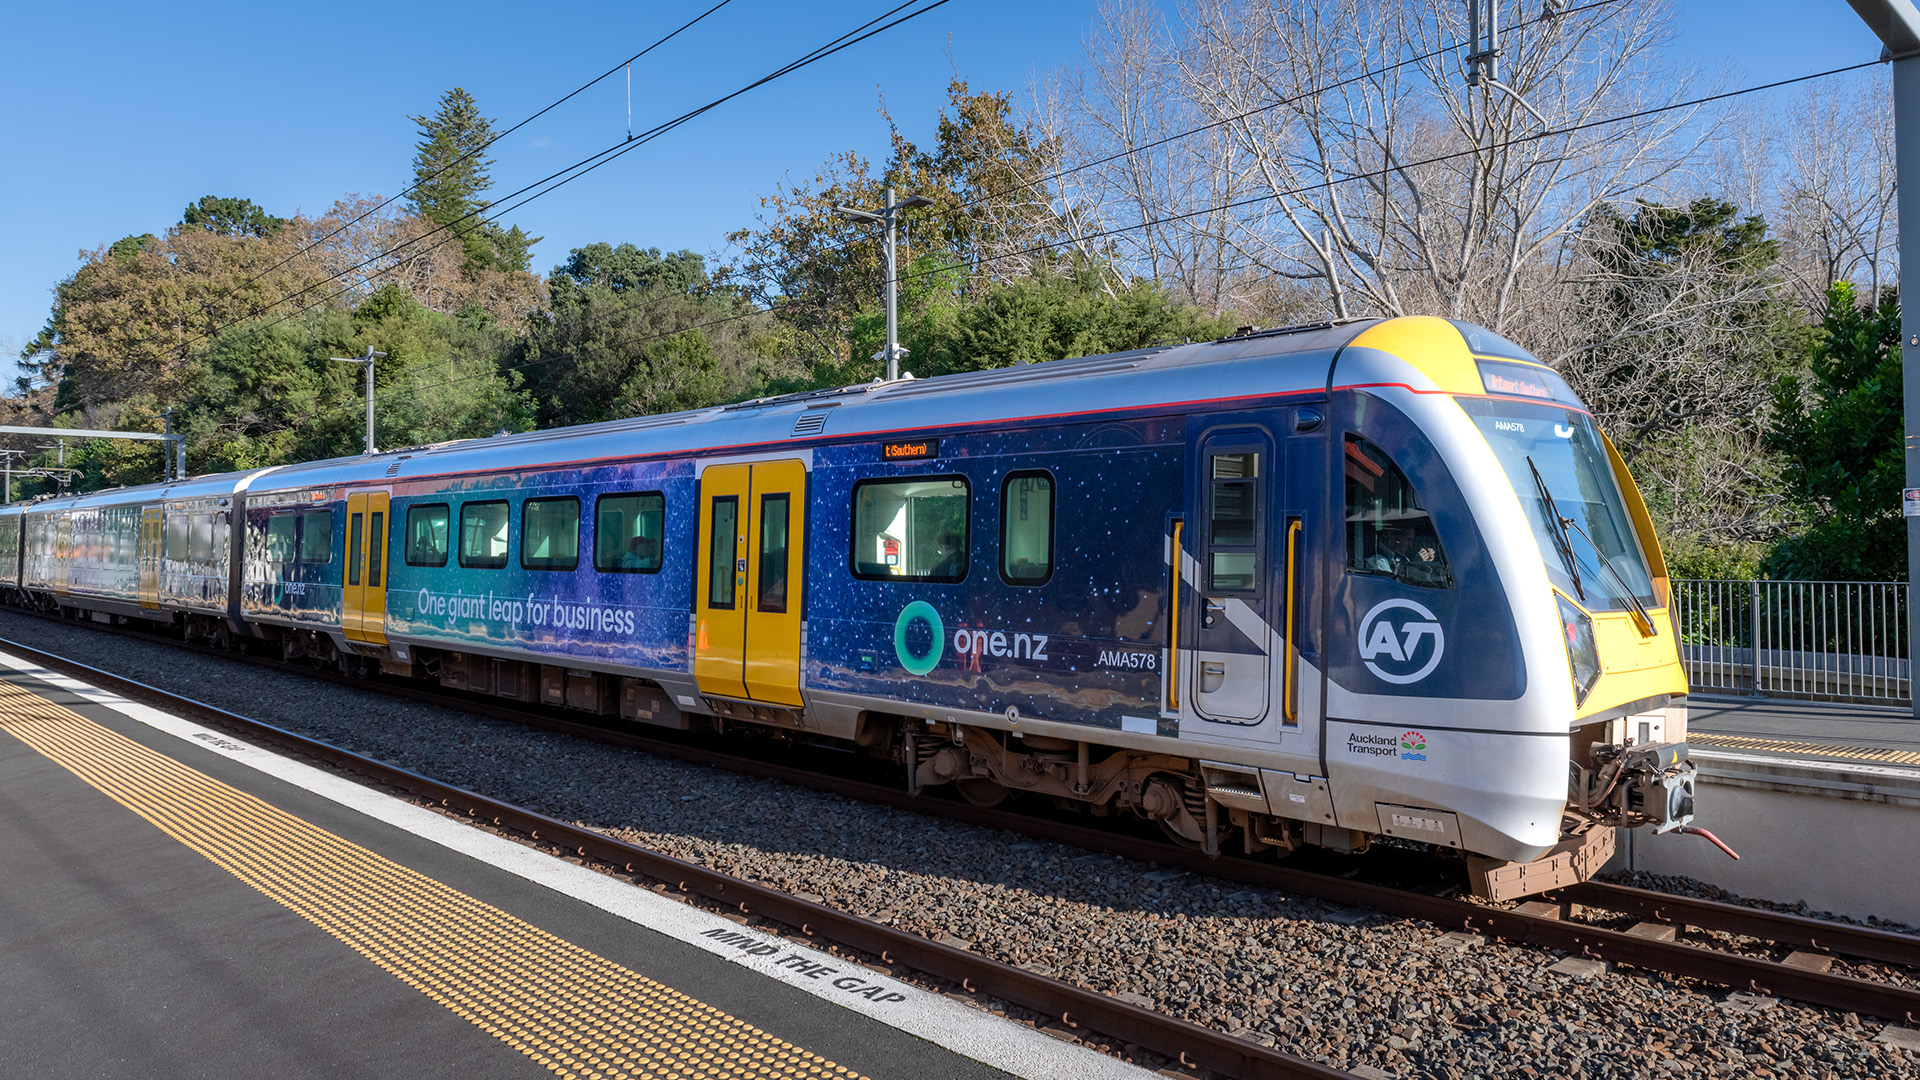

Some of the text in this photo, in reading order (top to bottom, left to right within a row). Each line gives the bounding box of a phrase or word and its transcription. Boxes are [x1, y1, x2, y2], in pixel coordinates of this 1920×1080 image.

[1495, 420, 1525, 433] AMA578
[885, 442, 927, 457] t (Southern)
[418, 588, 635, 635] One giant leap for business
[954, 629, 1048, 660] one.nz
[1098, 650, 1155, 669] AMA578
[1349, 733, 1397, 746] Auckland
[1347, 743, 1397, 757] Transport
[700, 928, 906, 1003] MIND THE GAP
